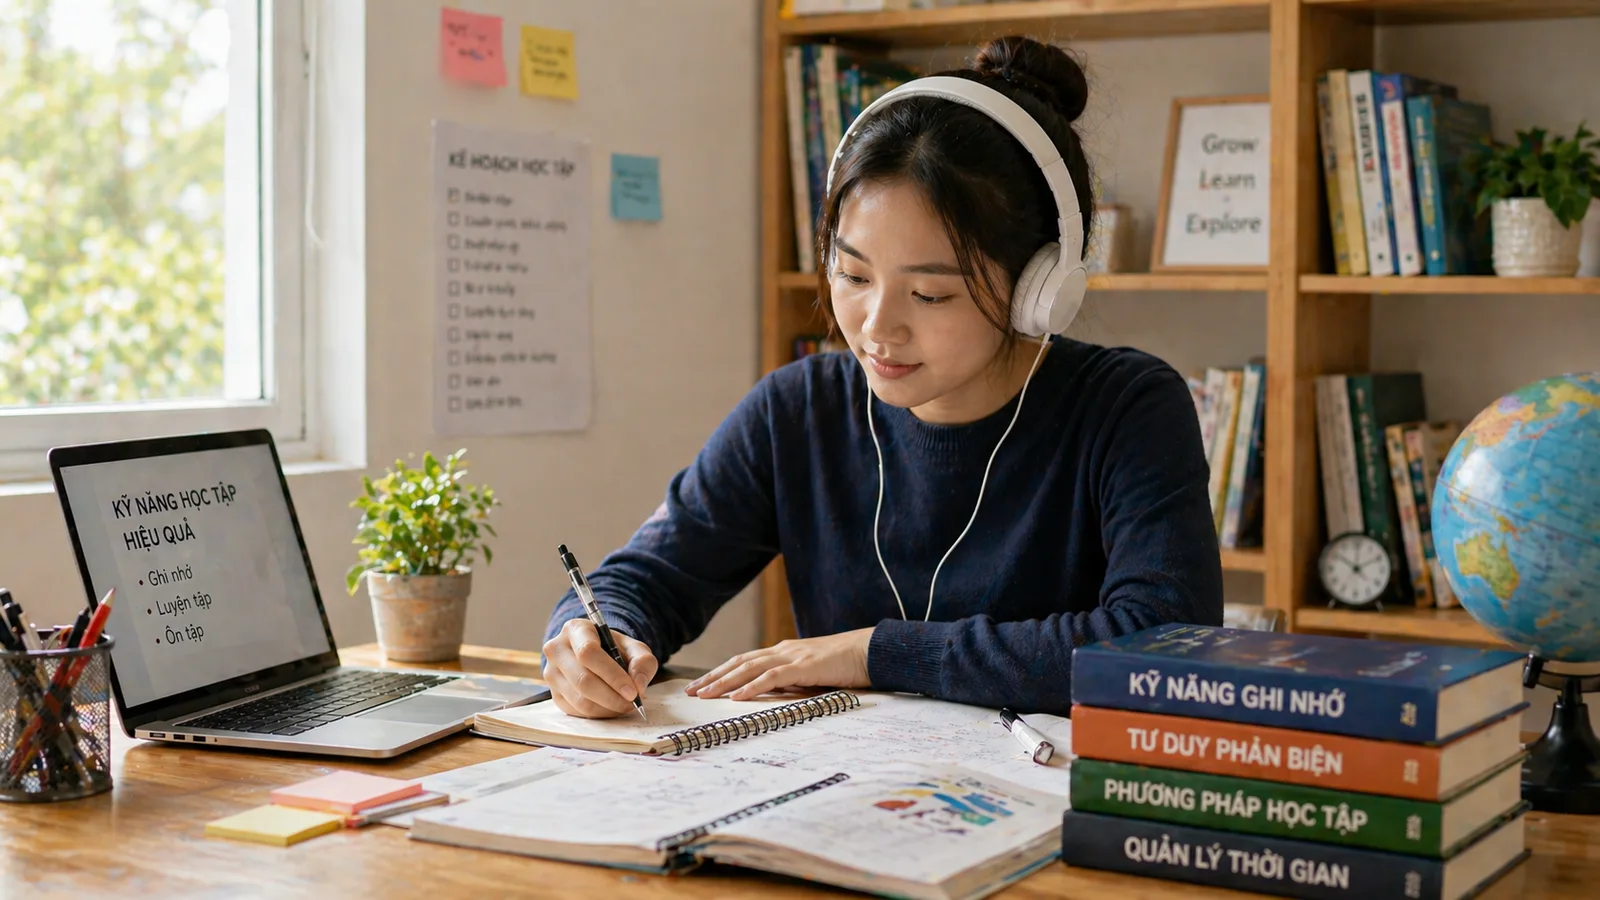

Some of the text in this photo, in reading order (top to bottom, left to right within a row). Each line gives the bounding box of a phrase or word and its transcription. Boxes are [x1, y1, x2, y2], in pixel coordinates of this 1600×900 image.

[1201, 133, 1260, 155] Grow
[1199, 169, 1256, 190] Learn
[1185, 211, 1262, 238] Explore
[112, 481, 236, 519] KỸ NĂNG HỌC TẬP
[123, 517, 196, 552] HIỆU QUẢ
[148, 569, 169, 586] Ghi
[156, 591, 212, 617] Luyện tập
[165, 624, 204, 645] Ôn tập
[1129, 669, 1346, 718] KỸ NĂNG GHI NHỚ
[1126, 727, 1343, 777] TƯ DUY PHẢN BIỆN
[1104, 778, 1196, 811] PHƯƠNG
[1201, 789, 1262, 818] PHÁP
[1266, 798, 1317, 829] HỌC
[1321, 802, 1369, 836] TẬP
[1124, 833, 1350, 890] QUẢN LÝ THỜI GIAN
